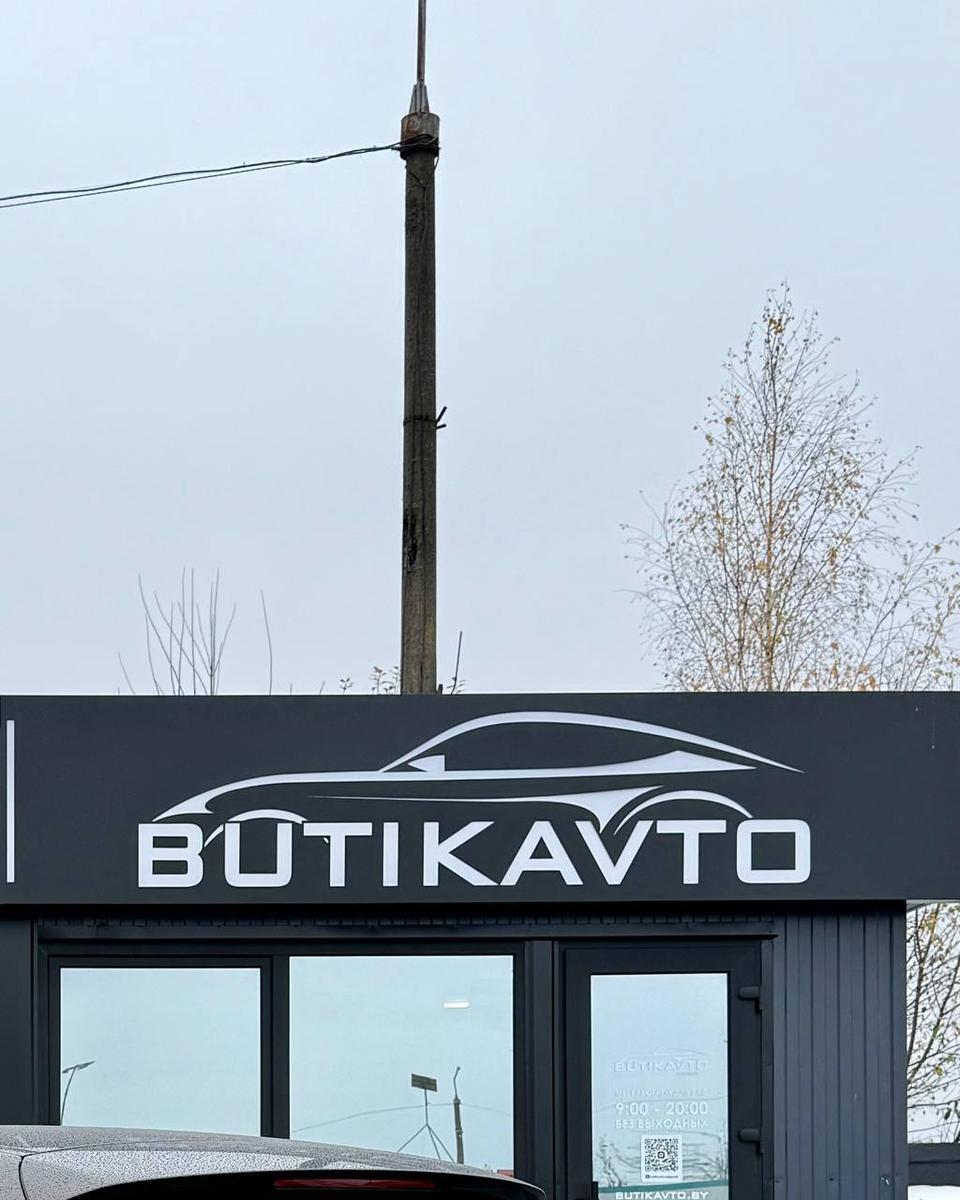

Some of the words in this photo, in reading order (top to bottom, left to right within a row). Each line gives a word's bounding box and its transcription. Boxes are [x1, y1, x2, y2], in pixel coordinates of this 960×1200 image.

[138, 817, 811, 888] BUTIKAVTO
[615, 1102, 648, 1116] 9:00
[665, 1101, 709, 1116] 20:00
[615, 1119, 635, 1129] БЕЗ
[615, 1191, 709, 1200] BUTIKAVTO.BY
